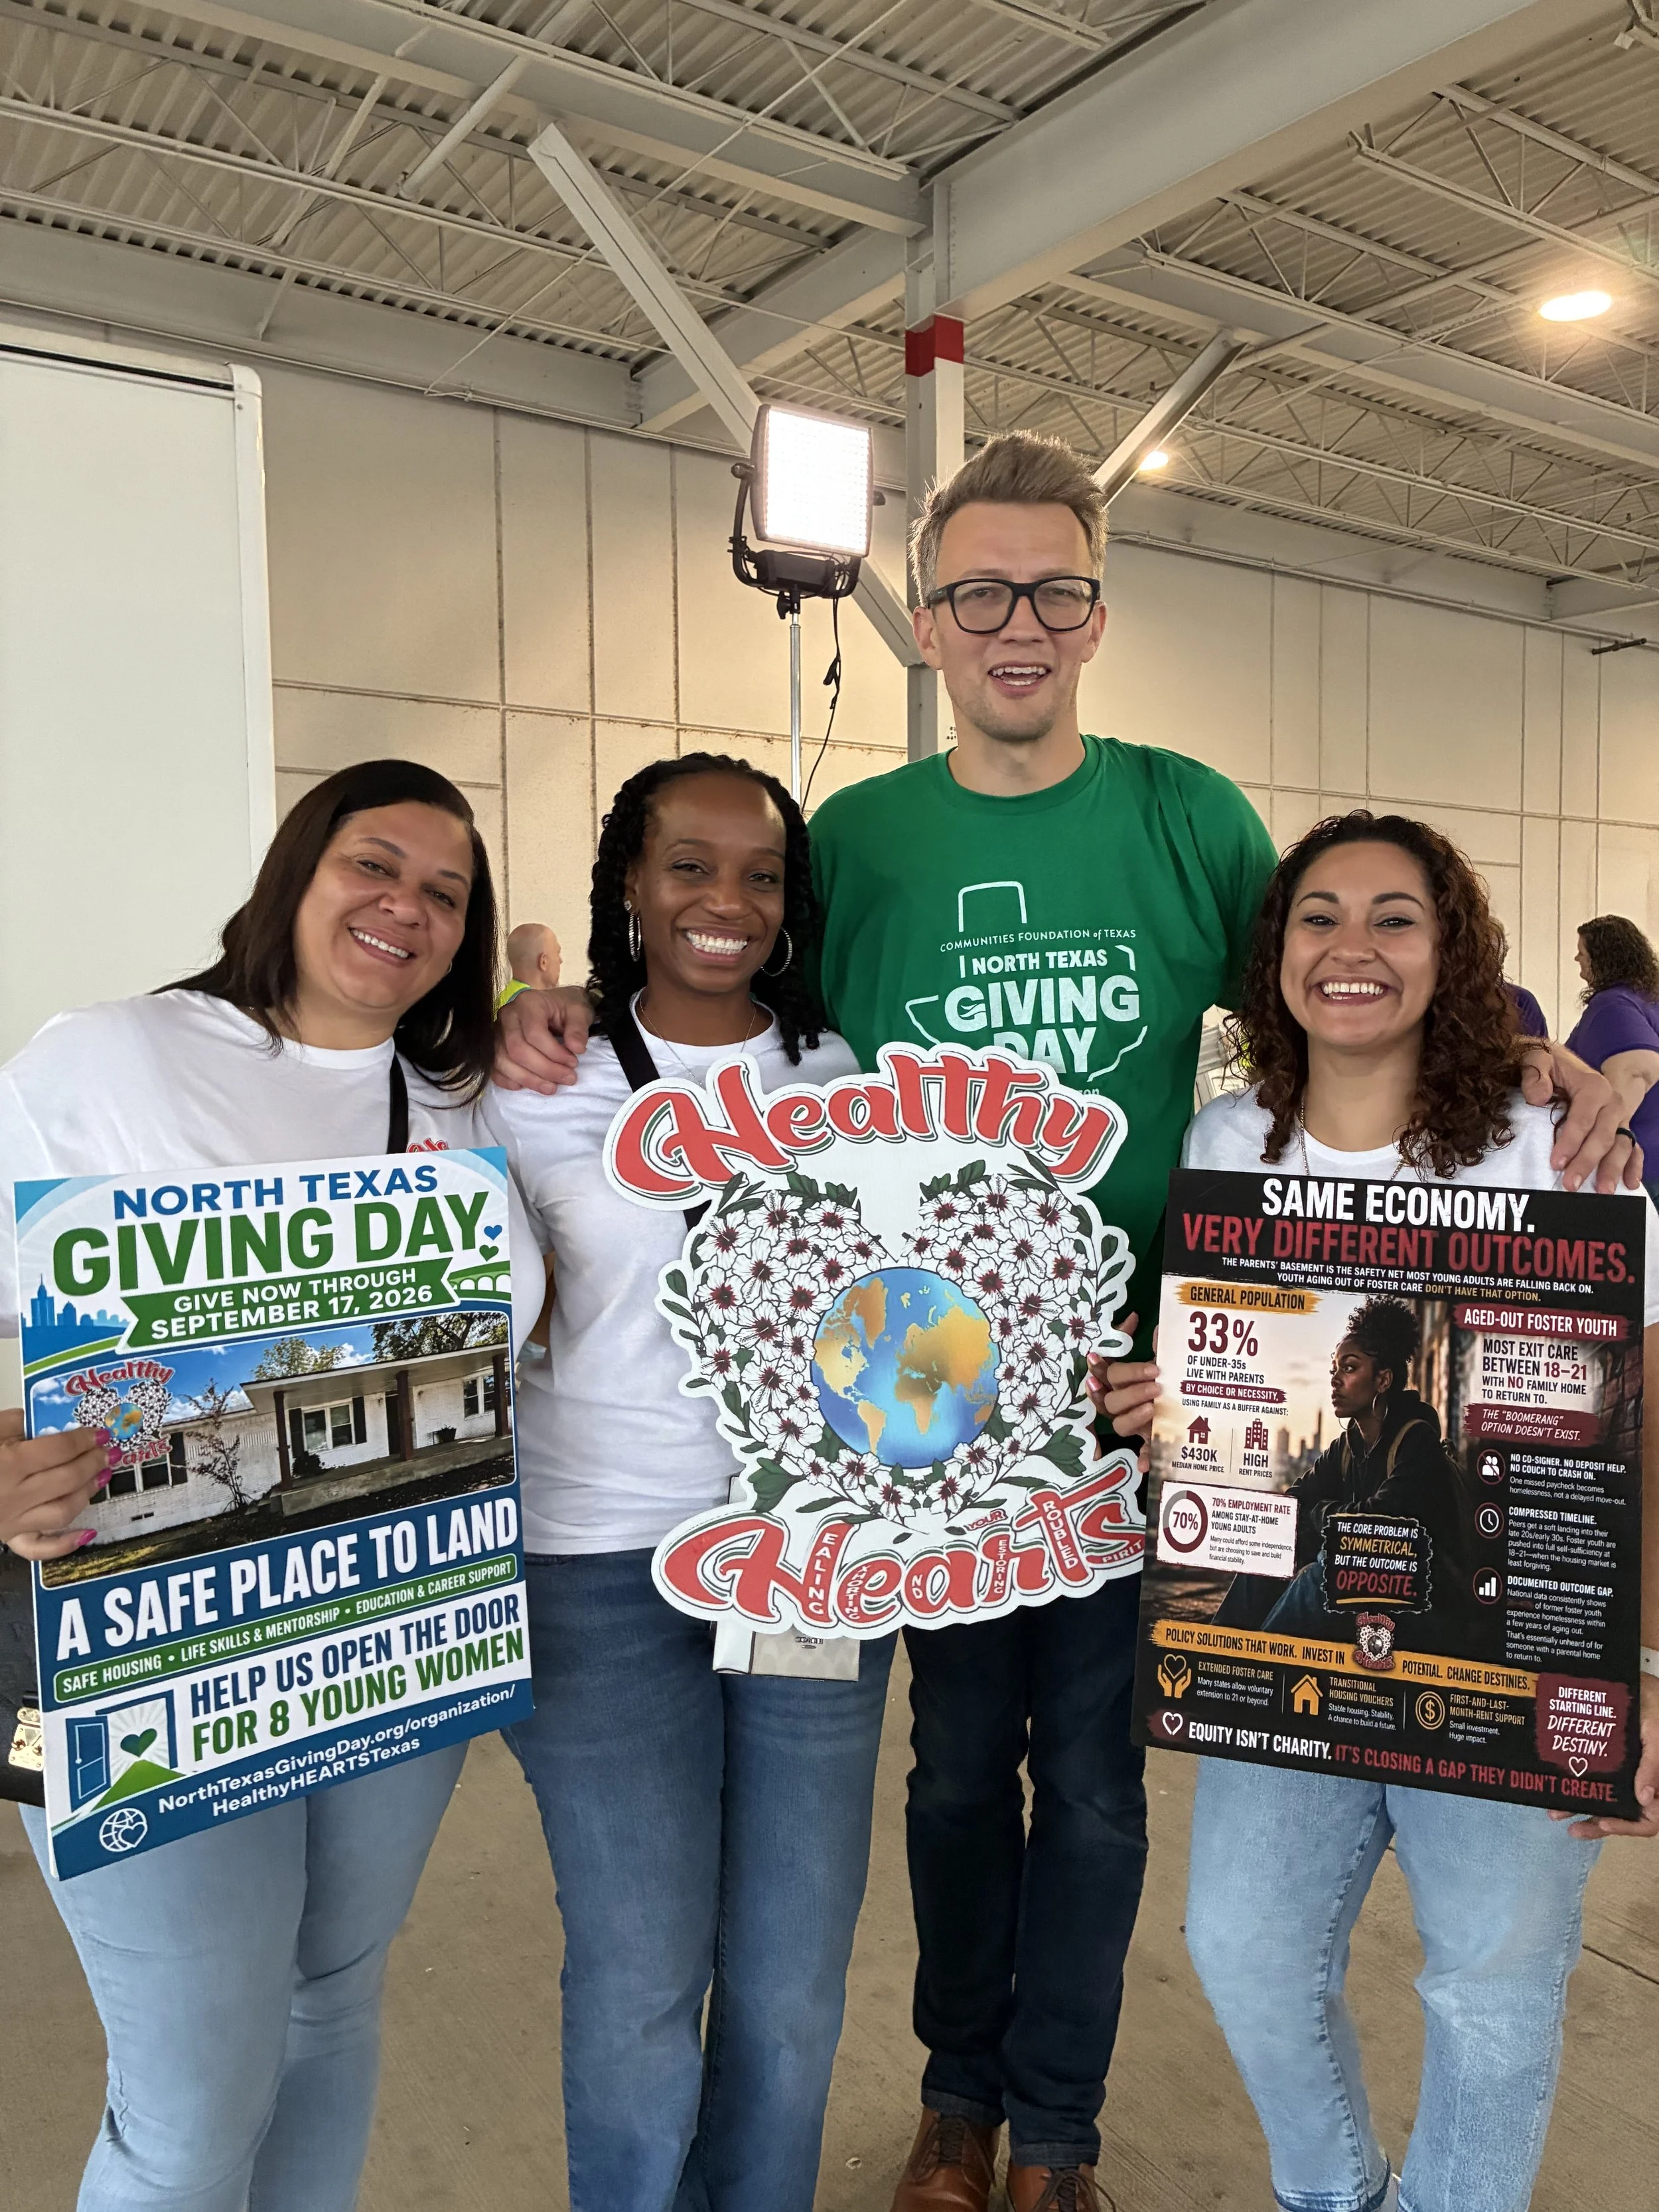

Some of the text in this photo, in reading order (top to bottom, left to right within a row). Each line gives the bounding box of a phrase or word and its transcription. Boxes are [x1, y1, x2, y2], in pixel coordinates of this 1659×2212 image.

[940, 929, 1136, 952] COMMUNITIES FOUNDATION of TEXAS
[972, 949, 1108, 976] NORTH TEXAS
[944, 974, 1140, 1033] GIVING
[613, 1048, 1117, 1198] Healthy
[114, 1165, 438, 1219] NORTH TEXAS
[1262, 1178, 1535, 1232] SAME ECONOMY.
[52, 1191, 490, 1297] GIVING DAY
[1183, 1213, 1635, 1284] VERY DIFFERENT OUTCOMES.
[1222, 1257, 1593, 1293] THE PARENTS' BASEMENT IS THE SAFETY NET MOST YOUNG ADULTS ARE FALLING BACK ON.
[174, 1268, 416, 1313] GIVE NOW THROUGH
[1190, 1286, 1305, 1310] GENERAL POPULATION
[151, 1284, 433, 1340] SEPTEMBER 17, 2026
[1465, 1308, 1617, 1336] AGED-OUT FOSTER YOUTH
[1188, 1311, 1258, 1357] 33%
[1483, 1339, 1578, 1361] MOST EXIT CARE
[1188, 1355, 1246, 1370] OF UNDER-35s
[1482, 1357, 1540, 1376] BETWEEN
[65, 1361, 175, 1395] Healthy
[1187, 1368, 1264, 1384] LIVE WITH PARENTS
[1482, 1376, 1587, 1394] WITH NO FAMILY HOME
[1186, 1383, 1195, 1392] BY
[1197, 1384, 1224, 1395] CHOICE
[1226, 1387, 1236, 1396] OR
[1482, 1409, 1500, 1419] THE
[122, 1439, 172, 1465] arts
[1181, 1446, 1217, 1462] $430K
[1244, 1453, 1269, 1467] HIGH
[1522, 1455, 1562, 1467] CO-SIGNER.
[1576, 1460, 1605, 1471] DEPOSIT
[1607, 1463, 1626, 1473] HELP.
[1212, 1497, 1291, 1514] 70% EMPLOYMENT RATE
[1509, 1507, 1597, 1525] COMPRESSED TIMELINE.
[967, 1510, 1007, 1530] YOUR
[1173, 1512, 1198, 1530] 70%
[1337, 1522, 1418, 1538] THE CORE PROBLEM IS
[662, 1457, 1145, 1627] Hearts
[1102, 1540, 1142, 1563] PIRIT
[1340, 1536, 1417, 1558] SYMMETRICAL,
[1334, 1555, 1417, 1572] BUT THE OUTCOME IS
[56, 1497, 518, 1661] A SAFE PLACE TO LAND
[1336, 1570, 1417, 1596] OPPOSITE.
[1508, 1576, 1614, 1597] DOCUMENTED OUTCOME GAP.
[62, 1561, 512, 1693] SAFE HOUSING LIFE SKILLS & MENTORSHIP EDUCATION & CAREER SUPPORT
[190, 1593, 520, 1718] HELP US OPEN THE DOOR
[1166, 1628, 1530, 1691] POLICY SOLUTIONS THAT WORK. INVEST IN POTENTIAL. CHANGE DESTINIES.
[192, 1627, 524, 1762] FOR 8 YOUNG WOMEN
[1559, 1687, 1607, 1704] DIFFERENT
[1550, 1699, 1617, 1718] STARTING LINE.
[1548, 1715, 1616, 1737] DIFFERENT
[158, 1684, 515, 1814] NorthTexasGivingDay.org/organization/
[1552, 1735, 1607, 1757] DESTINY.
[1189, 1722, 1618, 1802] EQUITY ISN'T CHARITY. IT'S CLOSING A GAP THEY DIDN'T CREATE.
[212, 1737, 420, 1816] HealthyHEARTSTexas
